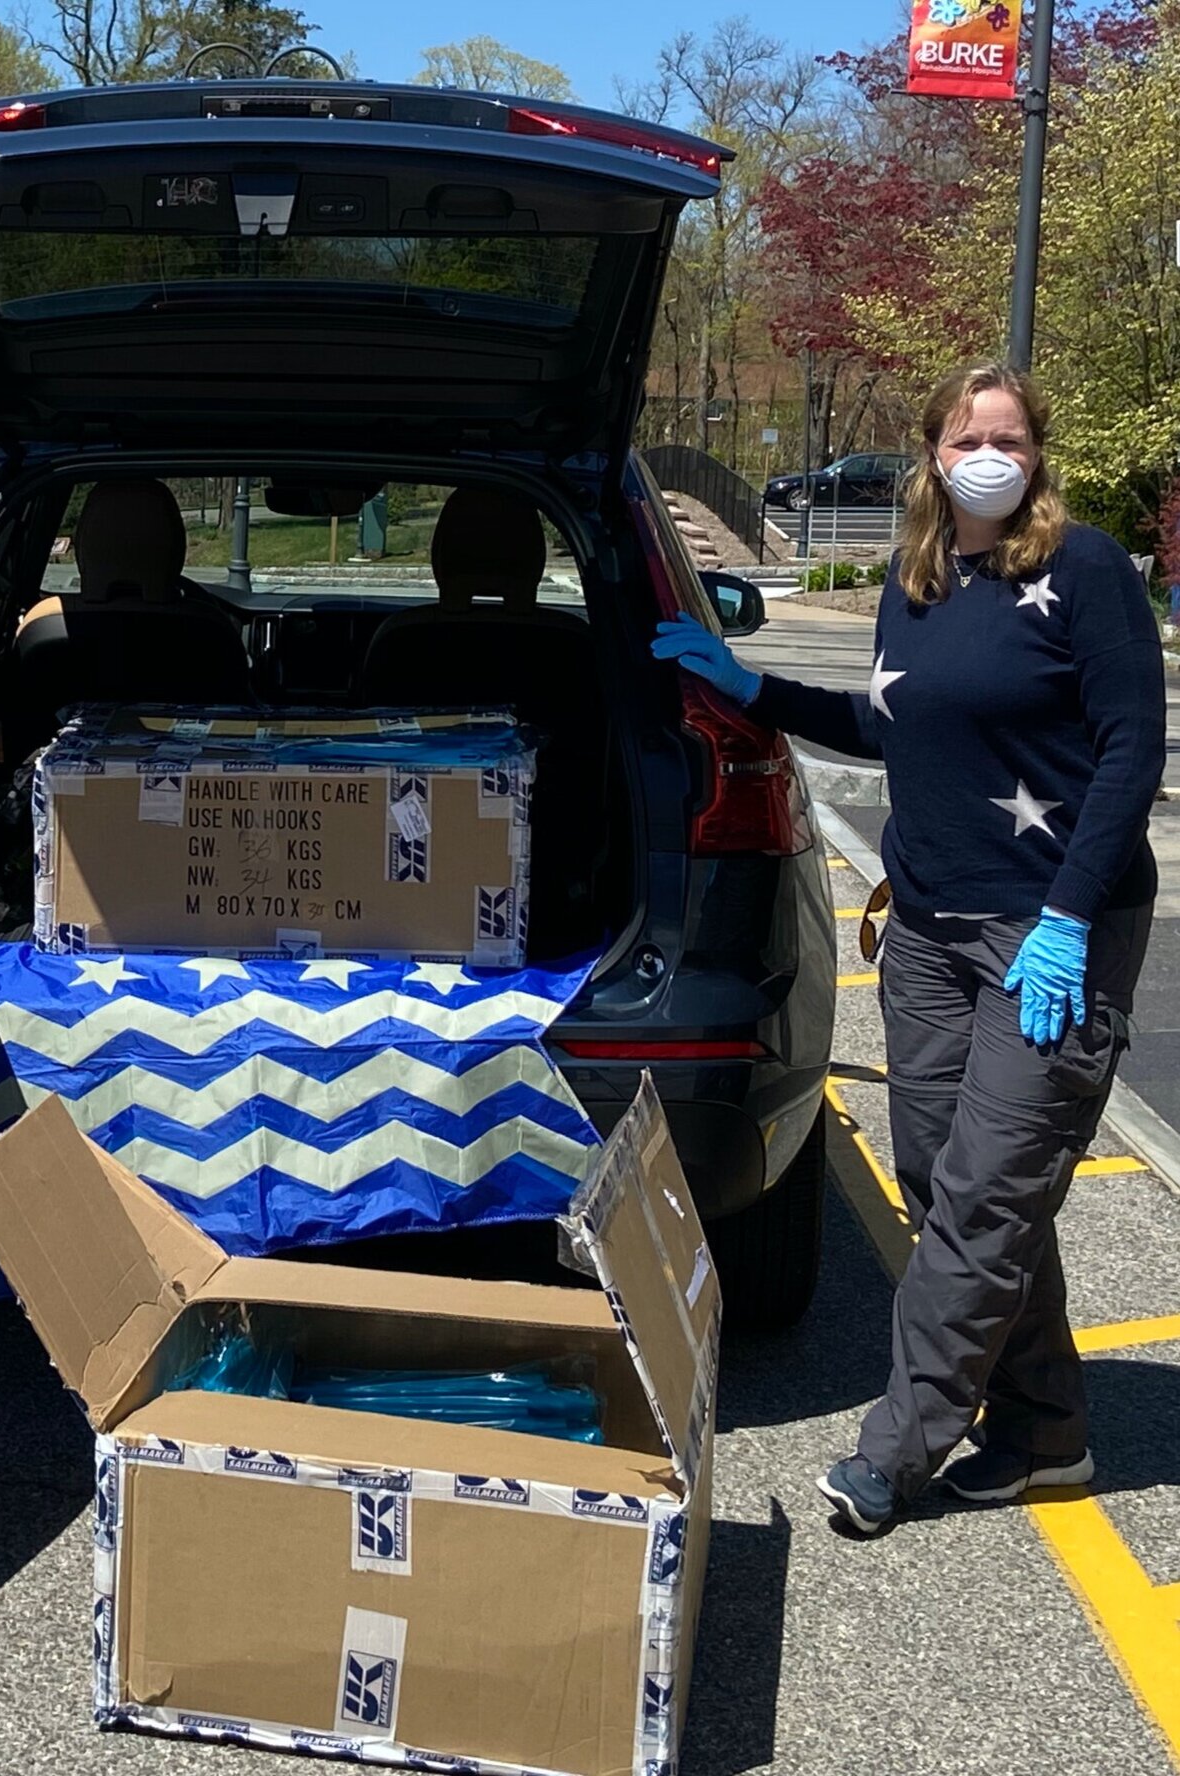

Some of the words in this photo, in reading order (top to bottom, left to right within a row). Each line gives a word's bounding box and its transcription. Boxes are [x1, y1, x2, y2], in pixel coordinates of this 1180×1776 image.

[921, 40, 1004, 67] BURKE
[920, 63, 970, 73] Rehabilitation
[972, 67, 1002, 75] Hospital
[189, 779, 260, 801] HANDLE
[270, 781, 312, 802] WITH
[322, 782, 369, 804] CARE
[189, 807, 222, 828] USE
[264, 809, 322, 831] HOOKS
[287, 839, 322, 861] KGS
[239, 867, 273, 895] 34
[287, 868, 322, 890] KGS
[186, 894, 200, 914] M
[217, 895, 240, 915] 80
[262, 897, 285, 917] 70
[335, 899, 362, 920] CM
[120, 1447, 180, 1461] SAILMAKERS
[228, 1459, 295, 1477] SAILMAKERS
[458, 1485, 526, 1502] SAILMAKERS
[574, 1501, 645, 1520] SAILMAKERS
[361, 1492, 395, 1557] UK
[395, 1492, 405, 1558] SAILMAKERS
[344, 1655, 384, 1722] UK
[379, 1662, 394, 1726] SAILMAKERS
